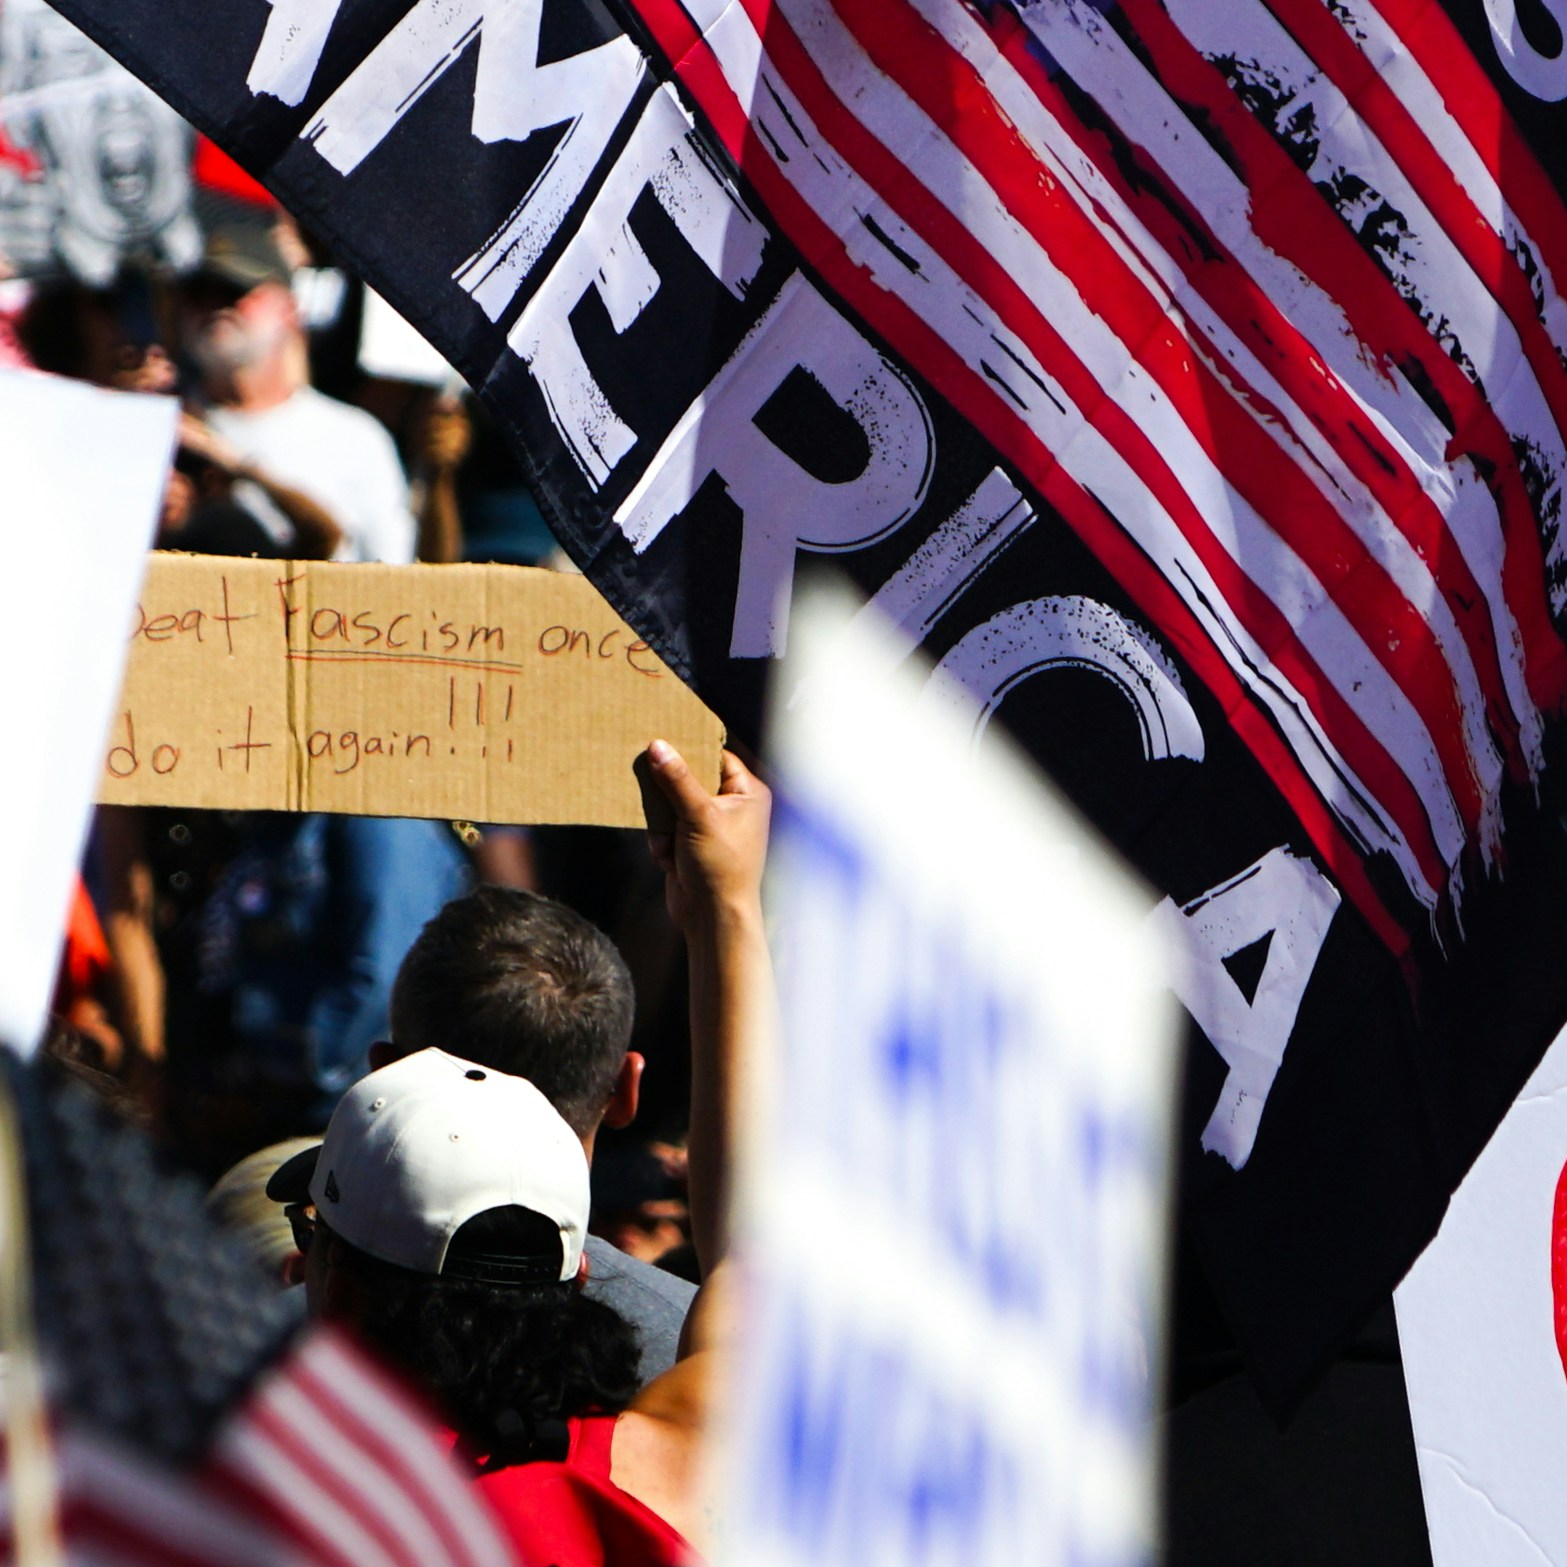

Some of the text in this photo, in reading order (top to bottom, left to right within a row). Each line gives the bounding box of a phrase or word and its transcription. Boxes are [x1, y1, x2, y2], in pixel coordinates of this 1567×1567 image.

[538, 622, 662, 678] once
[106, 711, 181, 779] do
[216, 706, 272, 774] it
